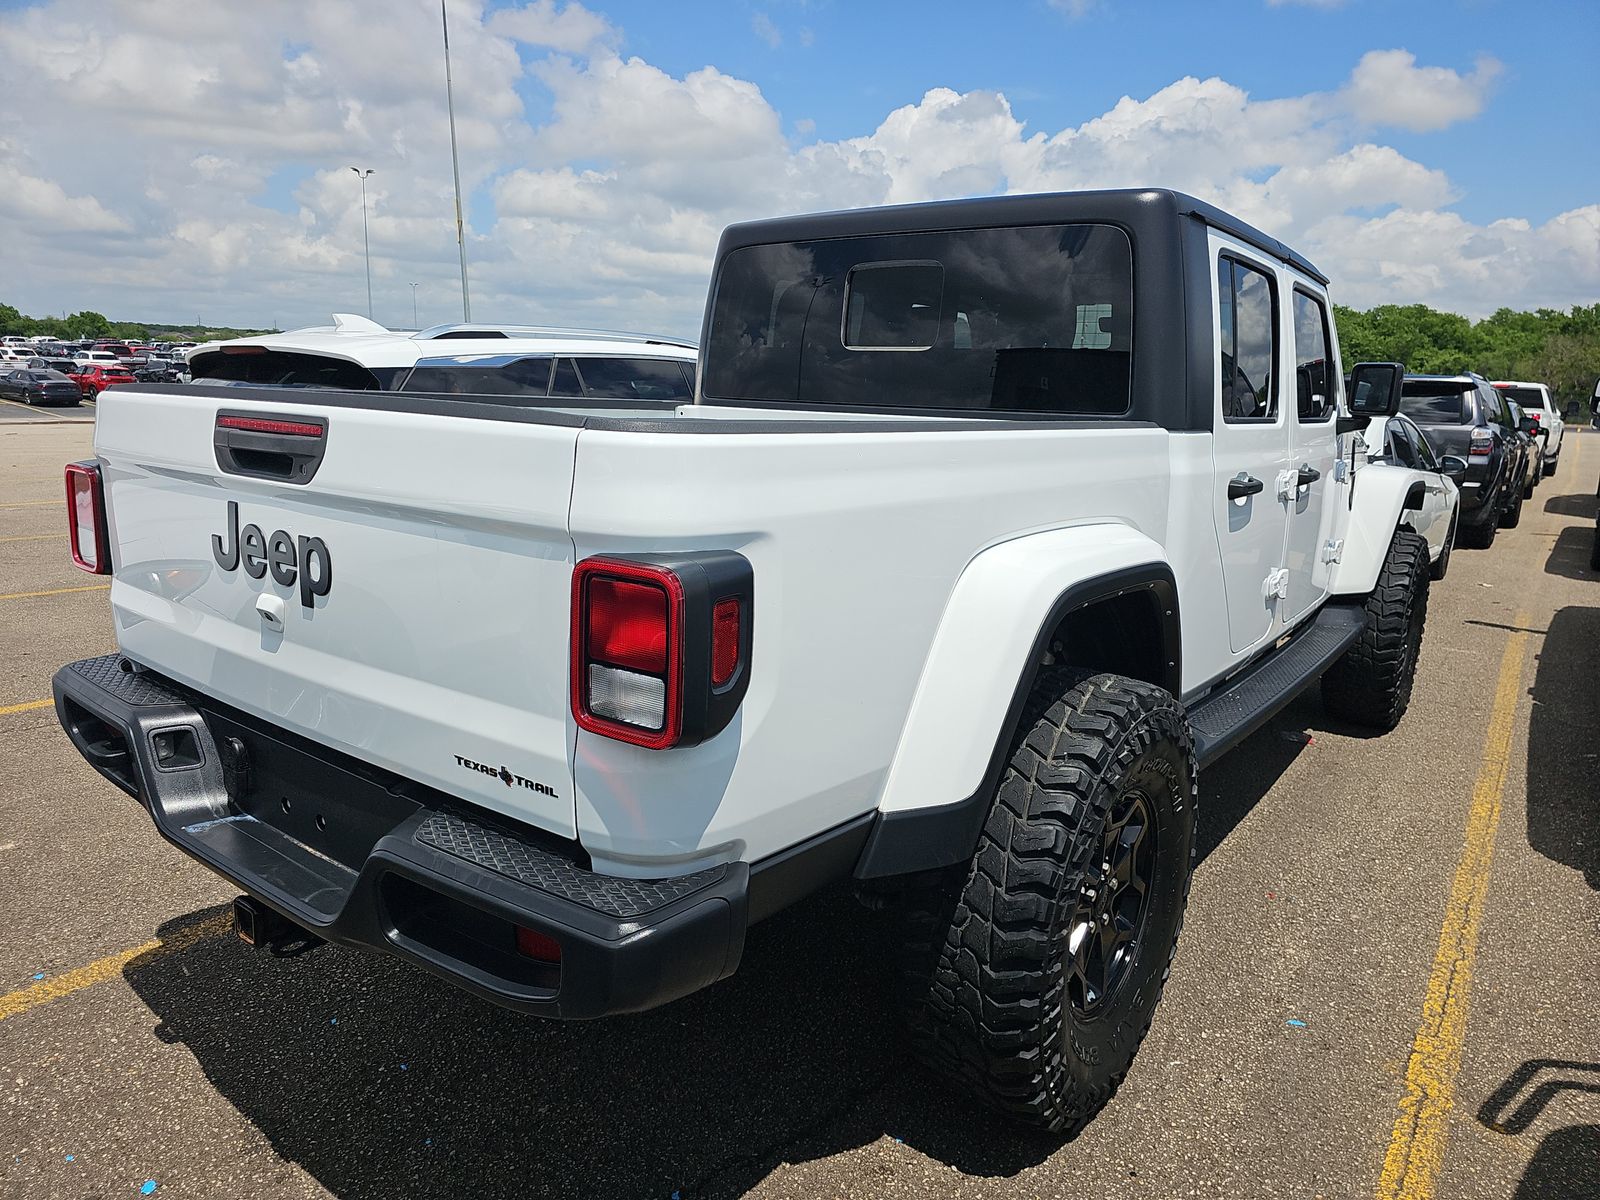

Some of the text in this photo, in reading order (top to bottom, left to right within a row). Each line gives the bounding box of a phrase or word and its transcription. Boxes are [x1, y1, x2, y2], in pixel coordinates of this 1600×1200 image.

[211, 501, 332, 608] Jeep
[454, 754, 559, 798] TEXAS TRAIL
